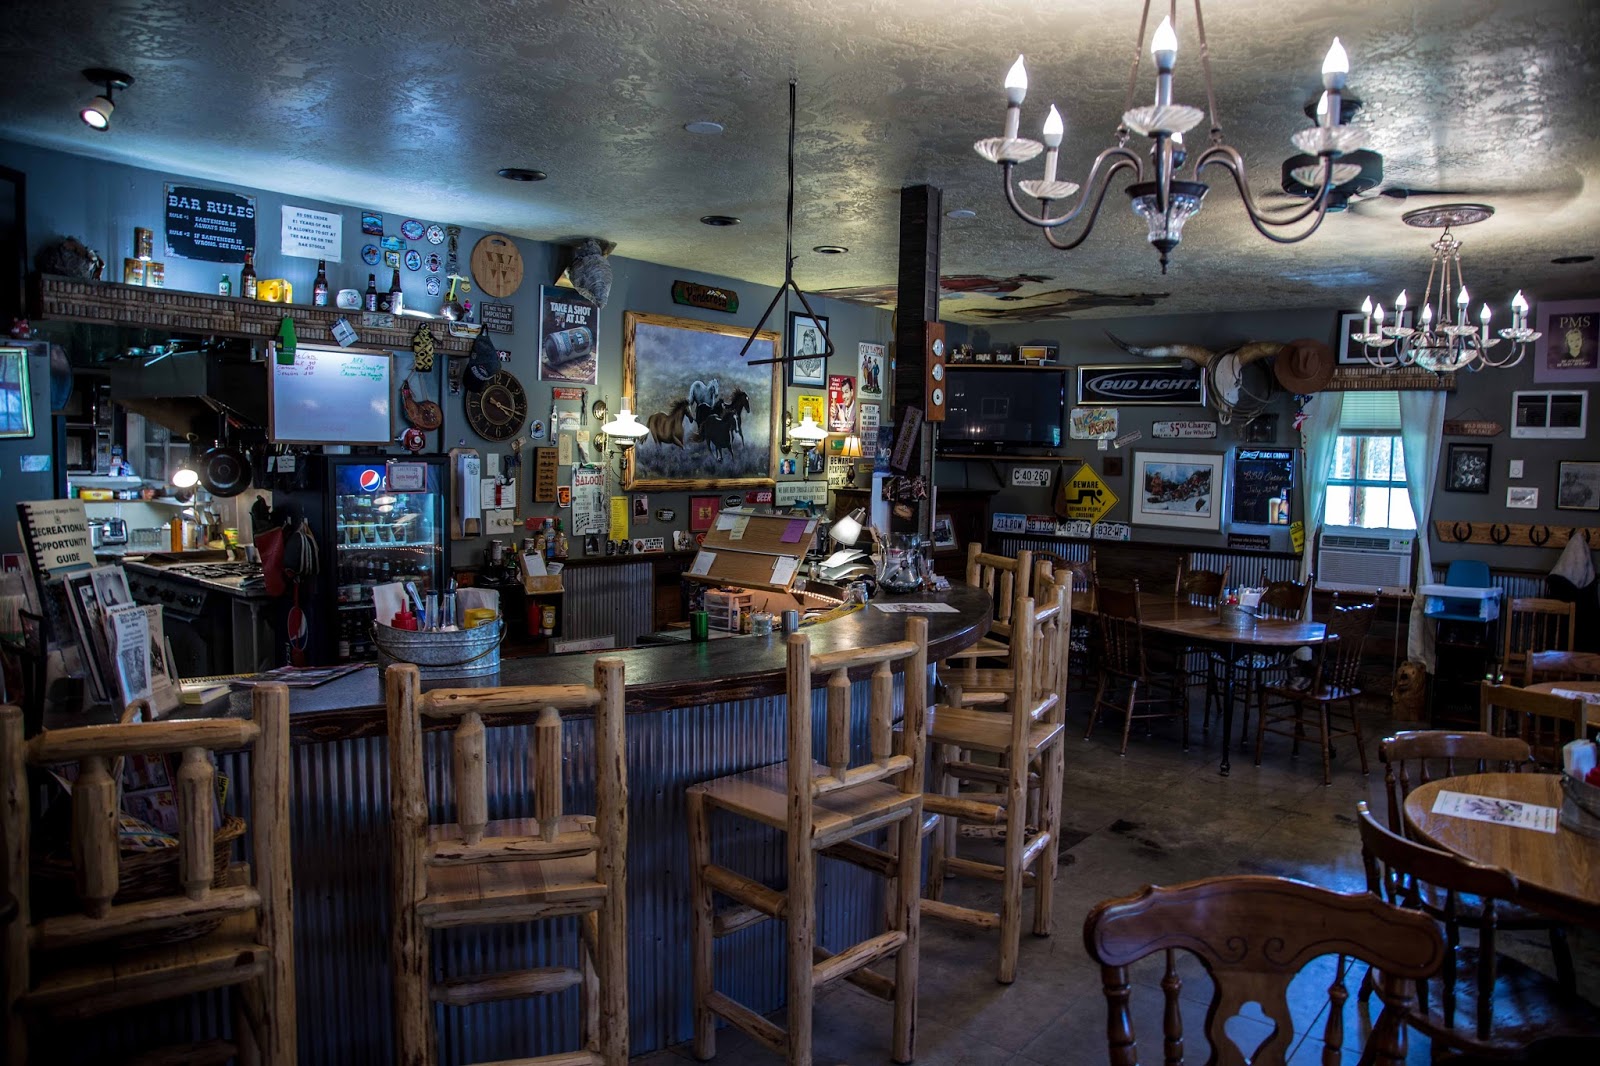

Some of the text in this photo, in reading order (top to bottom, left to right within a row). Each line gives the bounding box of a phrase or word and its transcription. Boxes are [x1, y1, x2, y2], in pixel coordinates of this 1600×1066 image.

[169, 195, 254, 218] BAR RULES
[195, 216, 228, 226] BARTENDER
[202, 234, 235, 244] BARTENDER
[218, 242, 229, 250] SEE
[550, 302, 591, 316] TAKE A SHOT
[485, 311, 510, 319] IMPORTANT
[566, 314, 587, 325] AT J.R.
[1560, 316, 1590, 328] PMS
[1100, 379, 1194, 390] BUD LIGHT
[1084, 410, 1107, 424] Cold
[1088, 420, 1115, 435] BEER
[1187, 422, 1211, 430] Charge
[830, 456, 848, 465] BEWAR
[575, 474, 604, 487] SALOON
[829, 477, 840, 485] LOOSE
[757, 492, 772, 502] BEER
[34, 523, 86, 536] RECREATIONAL
[38, 538, 86, 550] OPPORTUNITY
[56, 553, 80, 563] GUIDE
